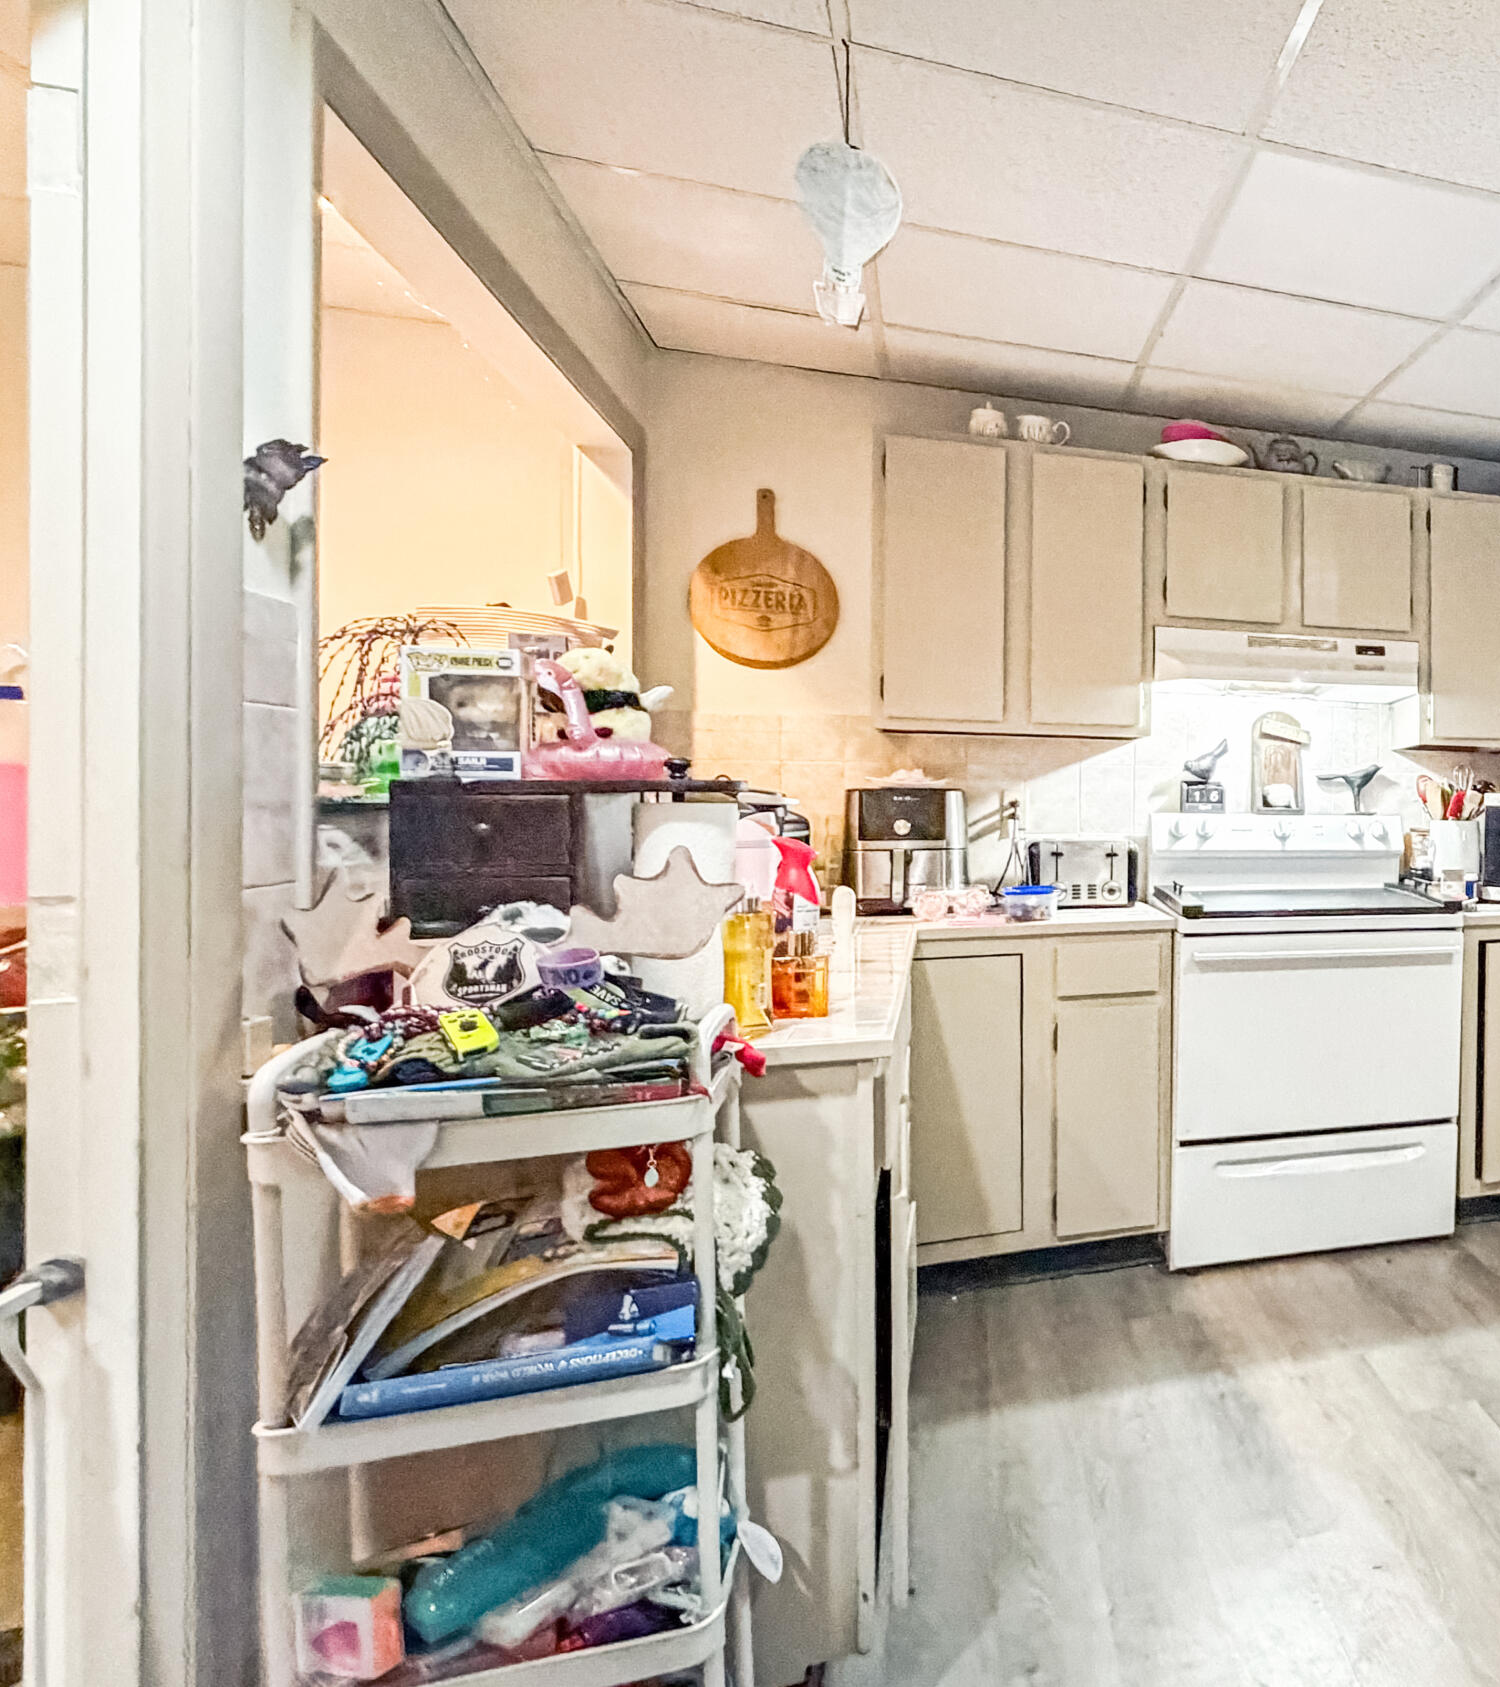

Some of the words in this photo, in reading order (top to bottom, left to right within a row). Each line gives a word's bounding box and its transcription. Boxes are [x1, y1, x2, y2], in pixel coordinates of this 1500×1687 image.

[719, 585, 808, 615] PIZZERIA
[457, 983, 507, 998] SPORTSMAN
[569, 1347, 638, 1368] DECEPTIONS
